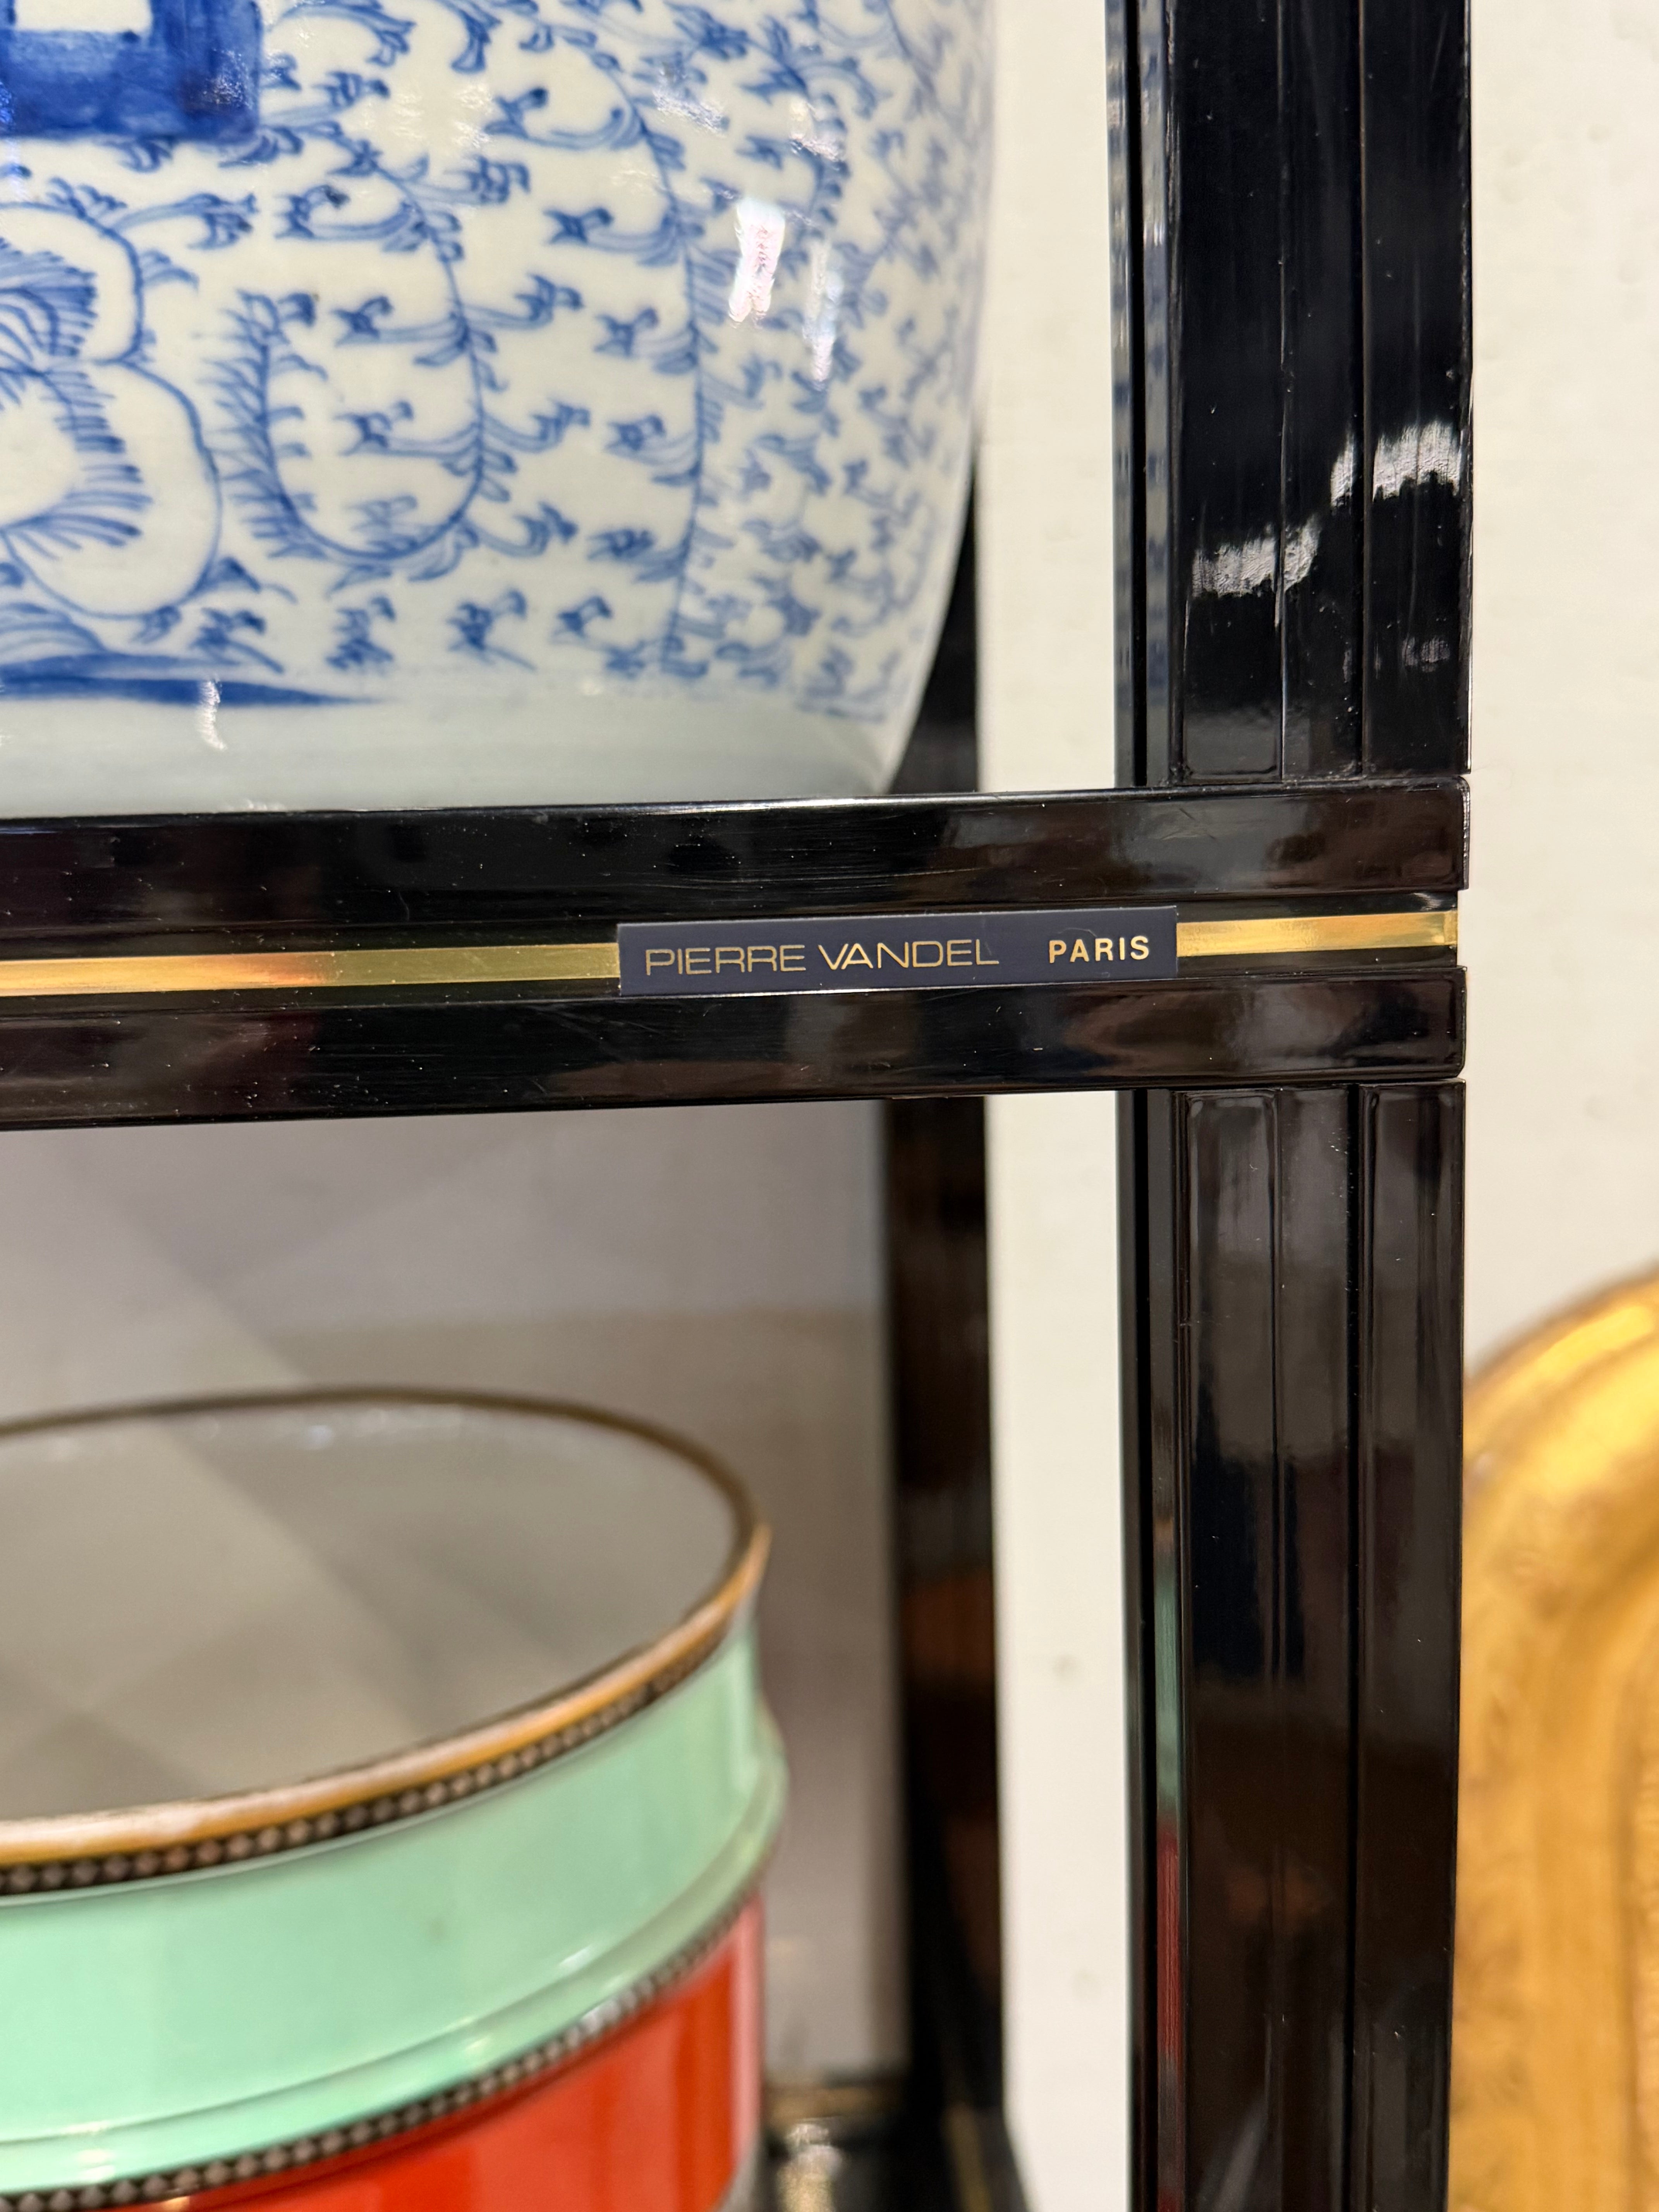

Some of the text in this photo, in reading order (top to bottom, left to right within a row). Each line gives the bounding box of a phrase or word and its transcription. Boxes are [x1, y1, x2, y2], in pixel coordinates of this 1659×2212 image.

[645, 935, 1150, 975] PIERRE VANDEL PARIS
